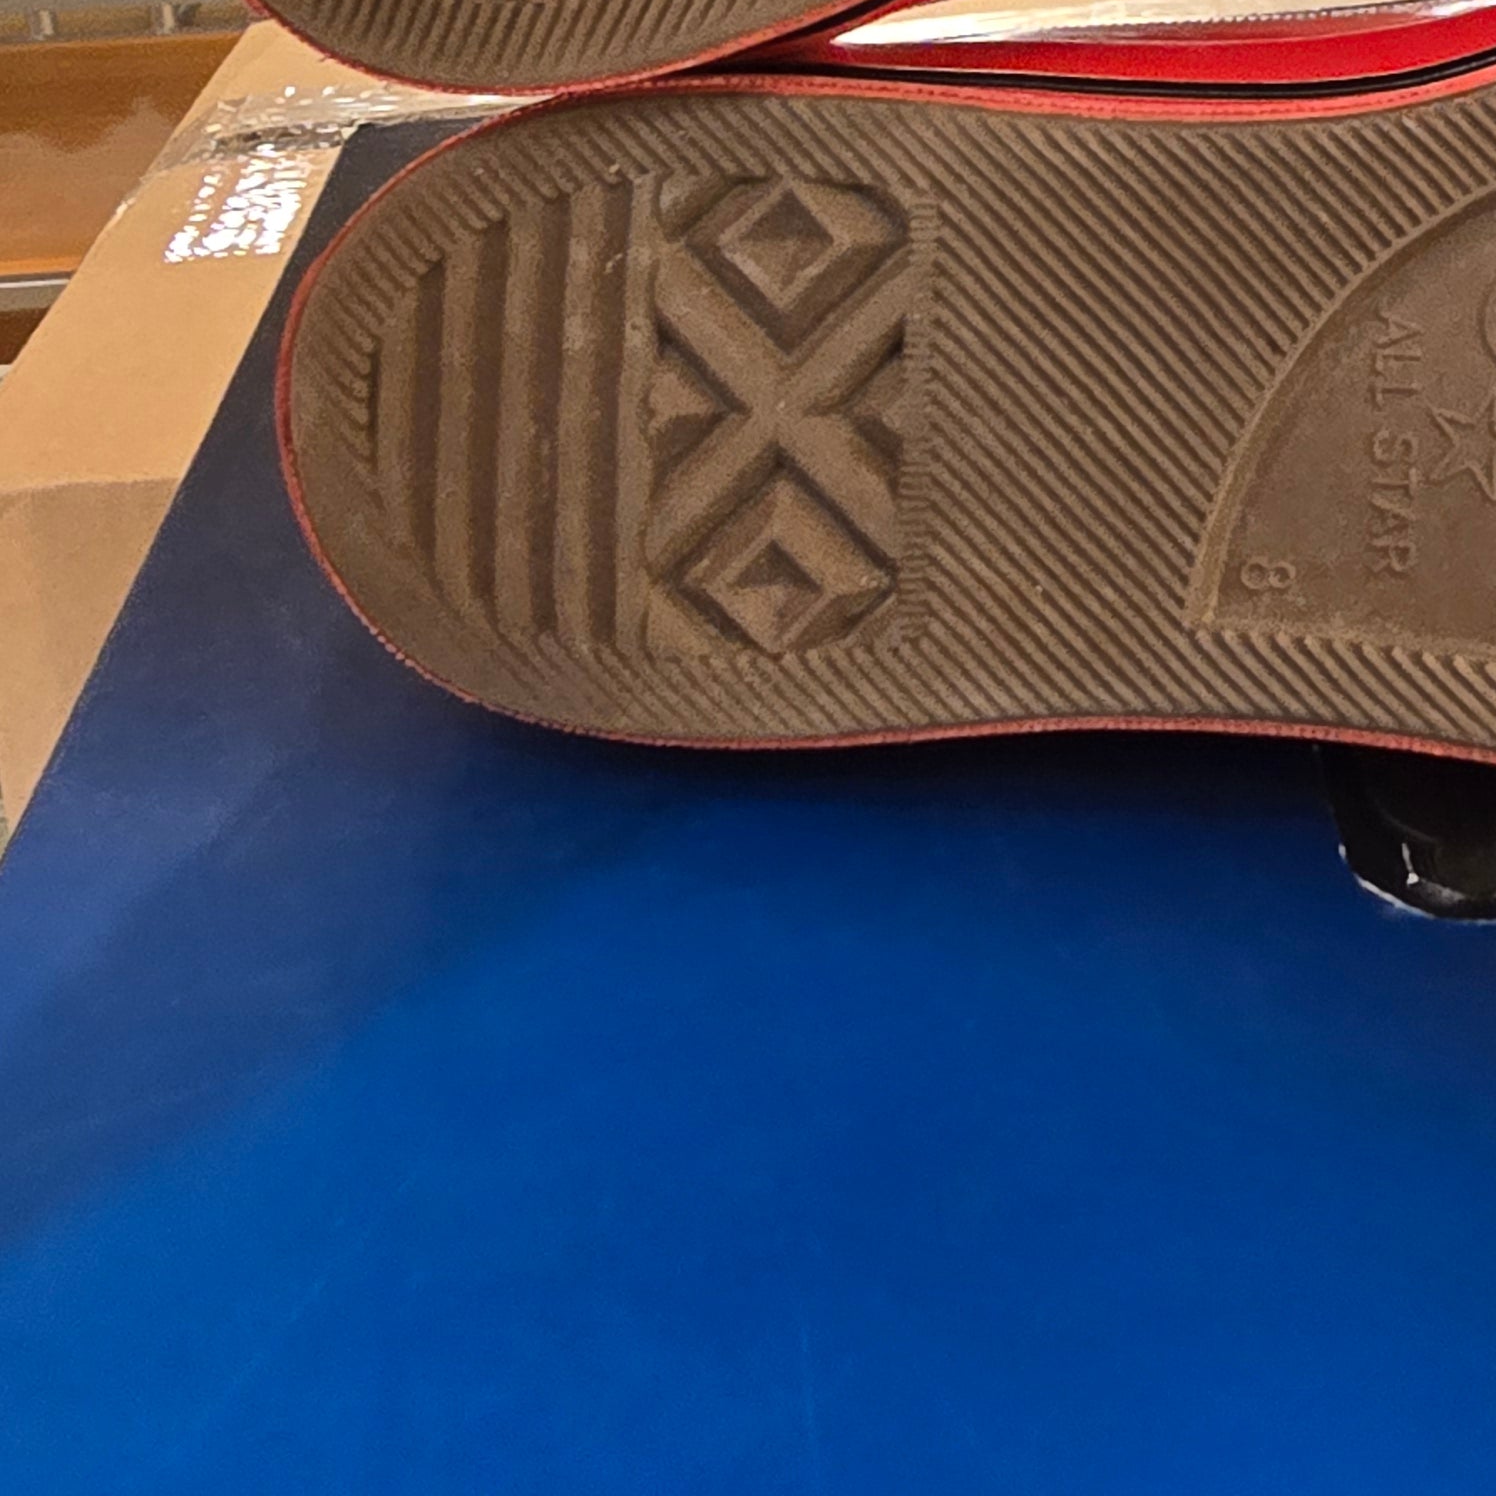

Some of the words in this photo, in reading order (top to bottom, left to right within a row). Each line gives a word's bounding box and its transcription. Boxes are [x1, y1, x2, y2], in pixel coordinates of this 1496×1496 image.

[1368, 308, 1423, 409] ALL
[1370, 428, 1422, 574] STAR
[1241, 557, 1296, 590] 8
